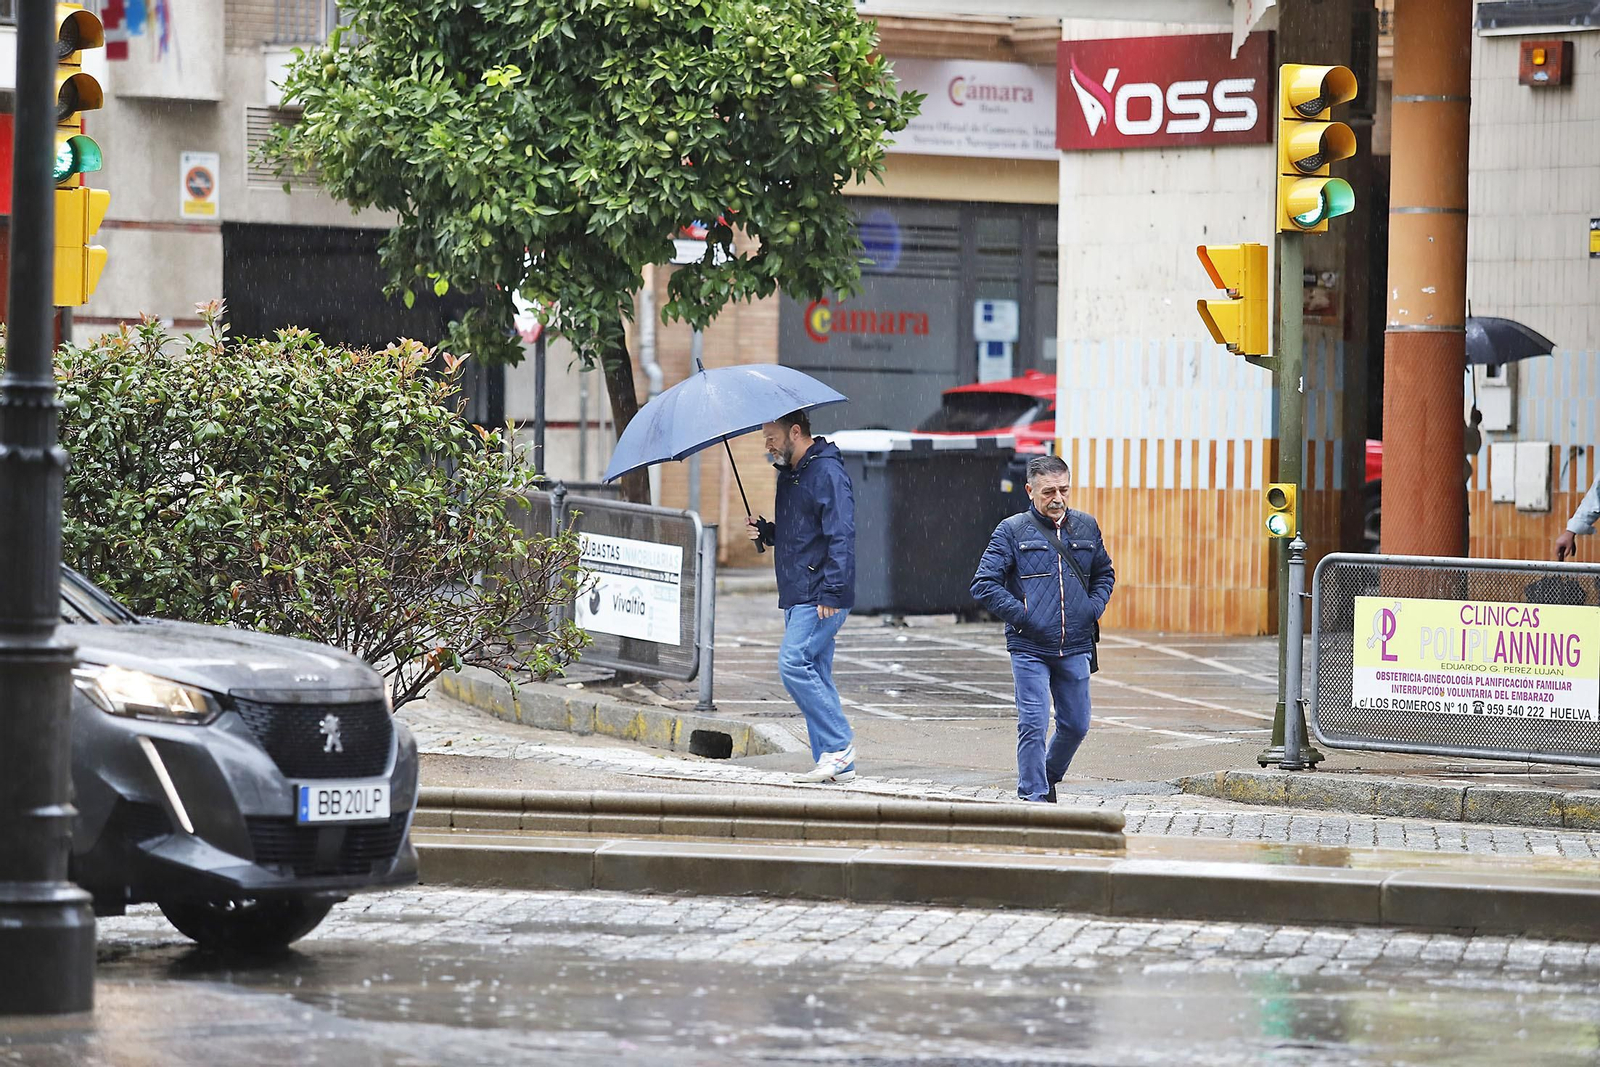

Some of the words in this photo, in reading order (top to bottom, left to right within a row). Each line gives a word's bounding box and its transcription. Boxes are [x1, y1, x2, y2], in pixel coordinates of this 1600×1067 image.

[948, 76, 1034, 106] Cámara
[804, 299, 930, 343] Cámara
[581, 540, 621, 561] SUBASTAS
[622, 546, 679, 570] INMOBILIARIAS
[612, 592, 646, 616] Vivaltia
[1460, 604, 1540, 628] CLINICAS
[1420, 626, 1581, 668] POLIPLANNING
[1440, 662, 1487, 672] EDUARDO
[1489, 665, 1501, 673] G.
[1503, 666, 1532, 675] PEREZ
[1534, 668, 1564, 676] LUJAN
[1446, 687, 1493, 699] VOLUNTARIA
[1494, 690, 1509, 700] DEL
[1511, 690, 1555, 702] EMBARAZO
[1475, 676, 1534, 689] PLANIFICACIÓN
[1536, 680, 1572, 691] FAMILIAR
[1359, 697, 1368, 708] c/
[1370, 697, 1389, 709] LOS
[1391, 698, 1441, 712] ROMEROS
[1457, 703, 1468, 714] 10
[1486, 703, 1504, 716] 959
[1507, 705, 1524, 717] 540
[1527, 706, 1544, 718] 222
[1550, 707, 1592, 721] HUELVA
